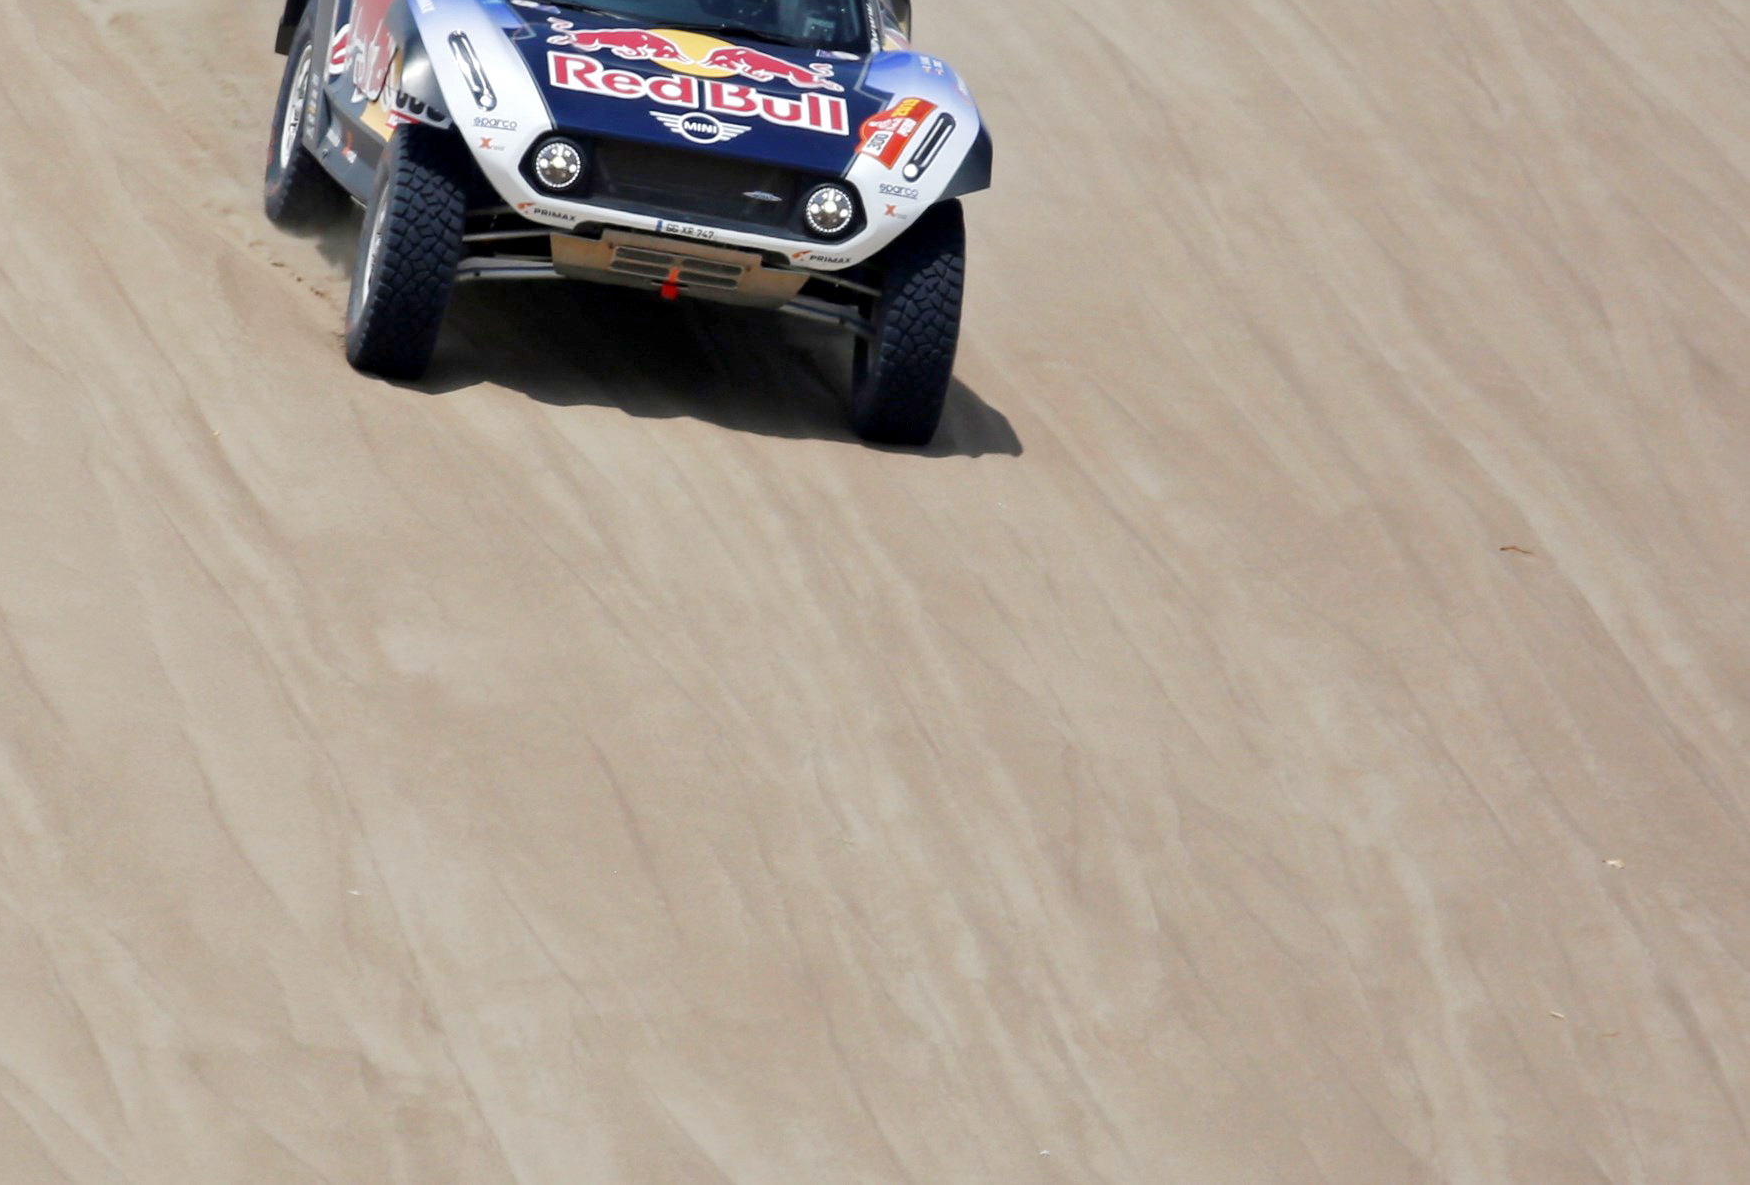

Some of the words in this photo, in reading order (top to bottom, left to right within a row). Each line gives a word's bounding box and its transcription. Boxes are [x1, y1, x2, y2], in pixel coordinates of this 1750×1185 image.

[548, 51, 699, 108] Red
[705, 80, 850, 135] Bull
[474, 117, 518, 131] sparco
[684, 120, 718, 135] MINI
[866, 133, 889, 152] 300
[879, 183, 919, 199] sparco
[534, 207, 575, 221] PRIMAX
[809, 254, 852, 265] PRIMAX
